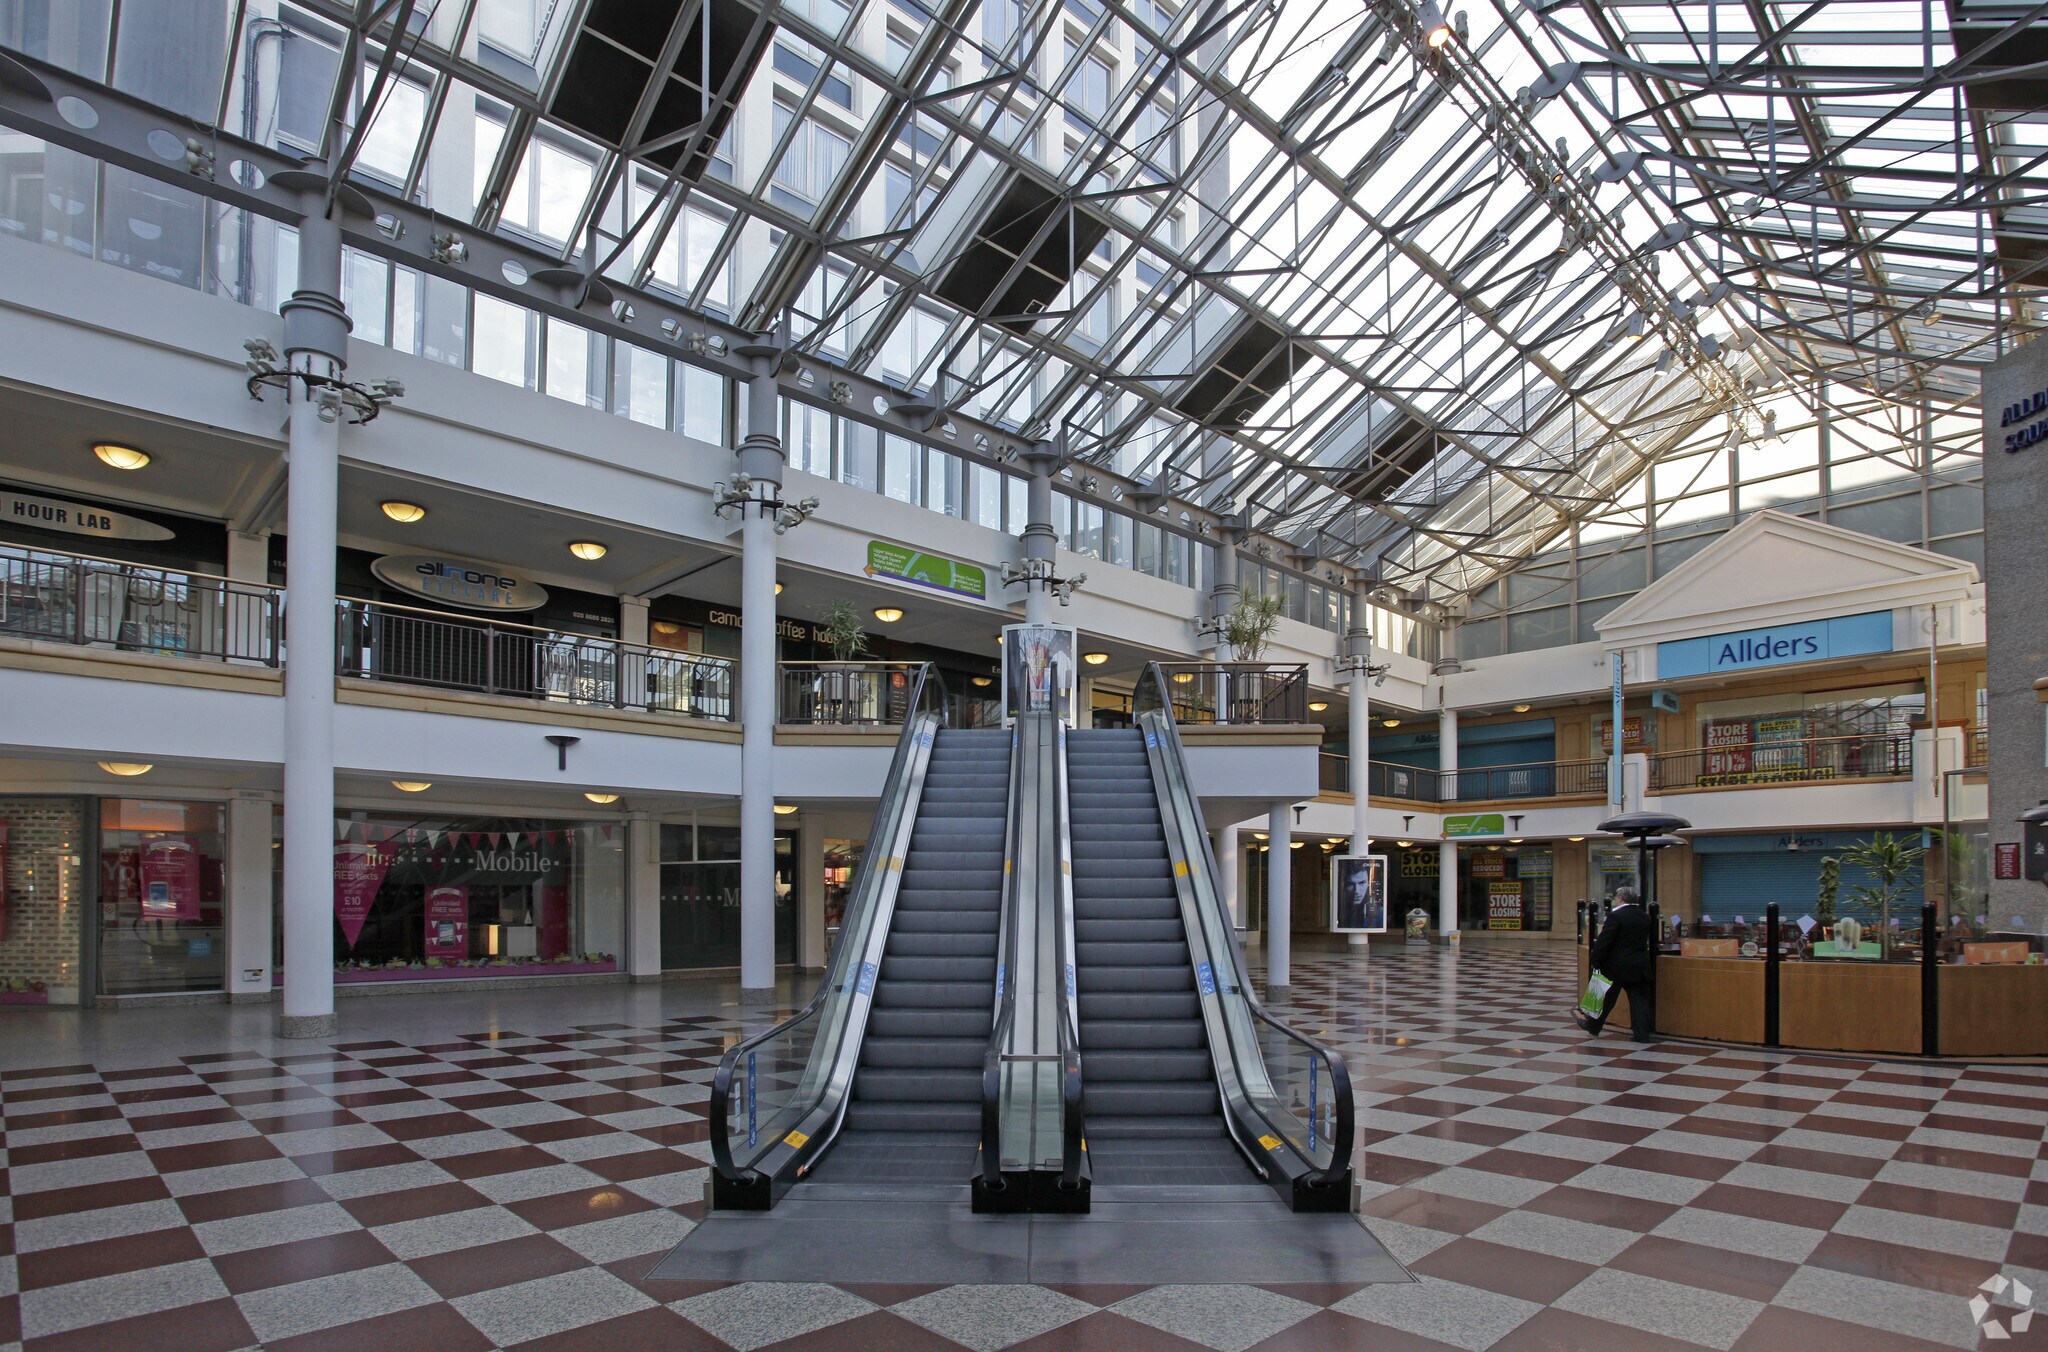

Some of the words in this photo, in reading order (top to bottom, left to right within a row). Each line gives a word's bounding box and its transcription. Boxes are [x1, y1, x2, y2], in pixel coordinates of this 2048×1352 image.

[2001, 388, 2048, 427] ALLD
[14, 501, 67, 523] HOUR
[77, 513, 111, 530] LAB
[422, 576, 512, 605] EYECARE
[1718, 636, 1818, 665] Allders
[1603, 730, 1640, 741] RECED!
[1708, 724, 1748, 738] STORE
[1708, 735, 1748, 746] CLOSING
[475, 850, 551, 872] Mobile
[334, 871, 354, 880] REE
[356, 872, 378, 880] texts
[1403, 866, 1440, 876] CLOSIN
[344, 897, 361, 905] £10
[1490, 894, 1521, 907] STORE
[1490, 907, 1521, 917] CLOSING
